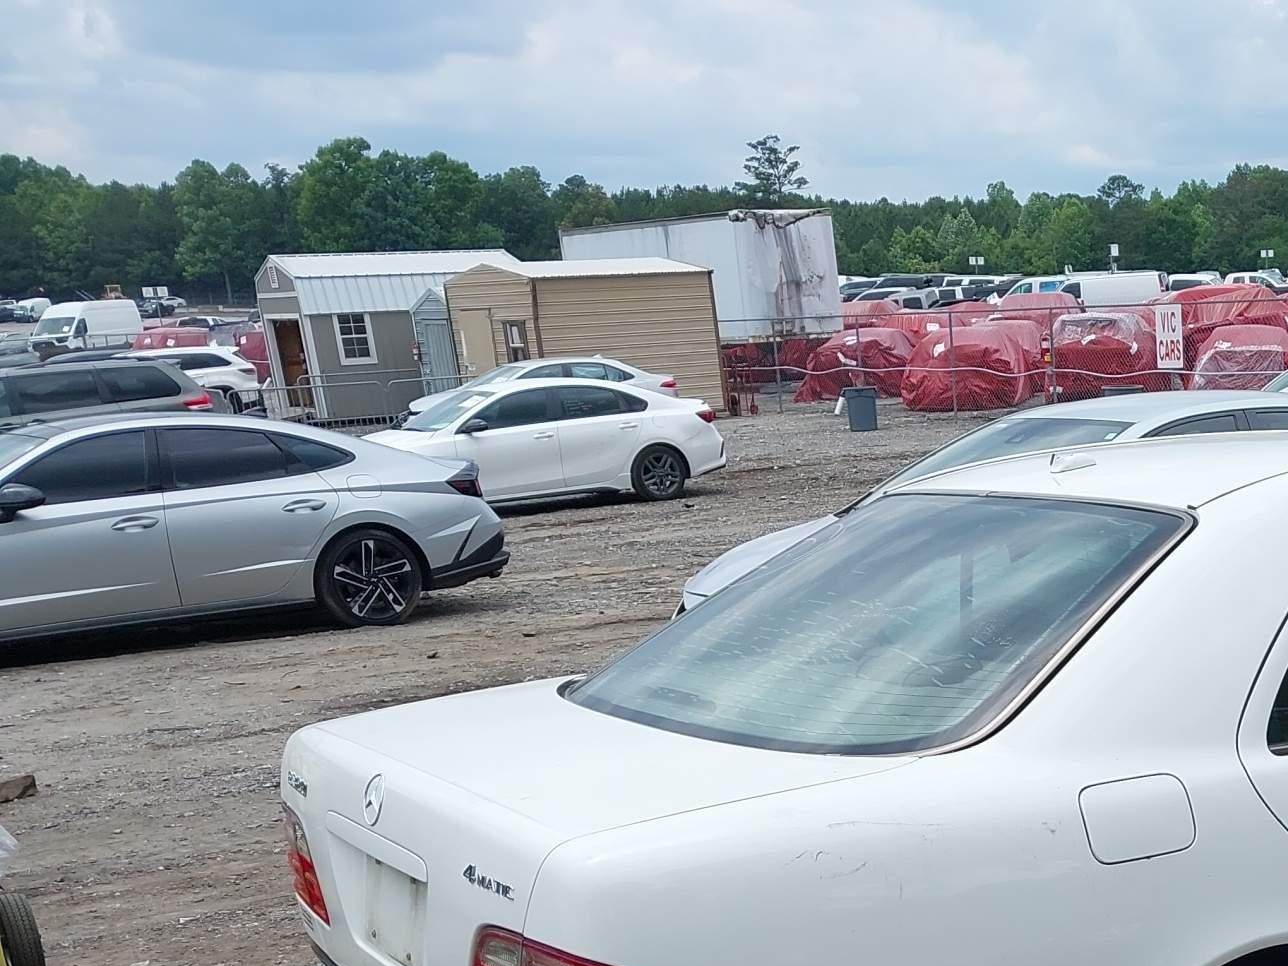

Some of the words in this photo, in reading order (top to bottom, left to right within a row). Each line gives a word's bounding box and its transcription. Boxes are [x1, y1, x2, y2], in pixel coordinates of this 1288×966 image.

[1160, 311, 1176, 333] VIC
[1159, 339, 1181, 361] CARS
[463, 864, 515, 901] 4MATIC
